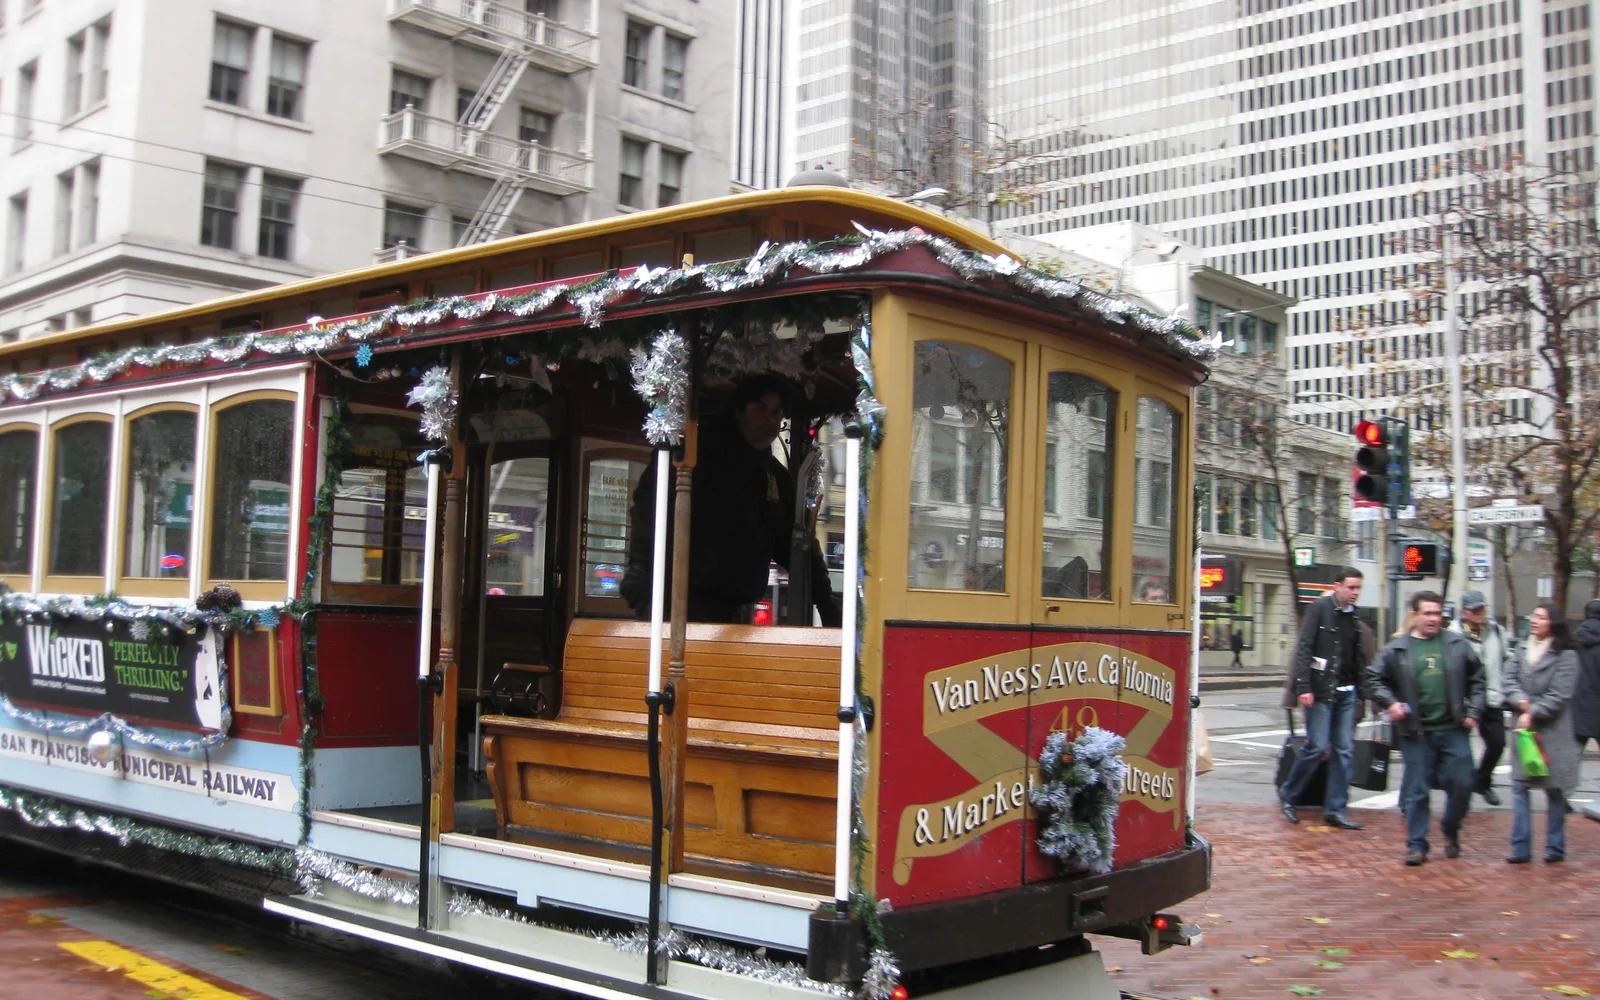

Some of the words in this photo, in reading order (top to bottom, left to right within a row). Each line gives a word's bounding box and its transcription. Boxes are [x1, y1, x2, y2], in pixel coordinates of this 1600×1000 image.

[1471, 509, 1540, 521] CALIFORNIA
[931, 676, 985, 714] Van
[983, 663, 1042, 701] Ness
[1097, 653, 1173, 705] California
[1049, 705, 1099, 740] 49
[1, 732, 26, 752] SAN
[203, 769, 276, 801] RAILWAY
[1119, 763, 1174, 799] treets
[914, 806, 934, 845] &
[941, 773, 1035, 843] Market
